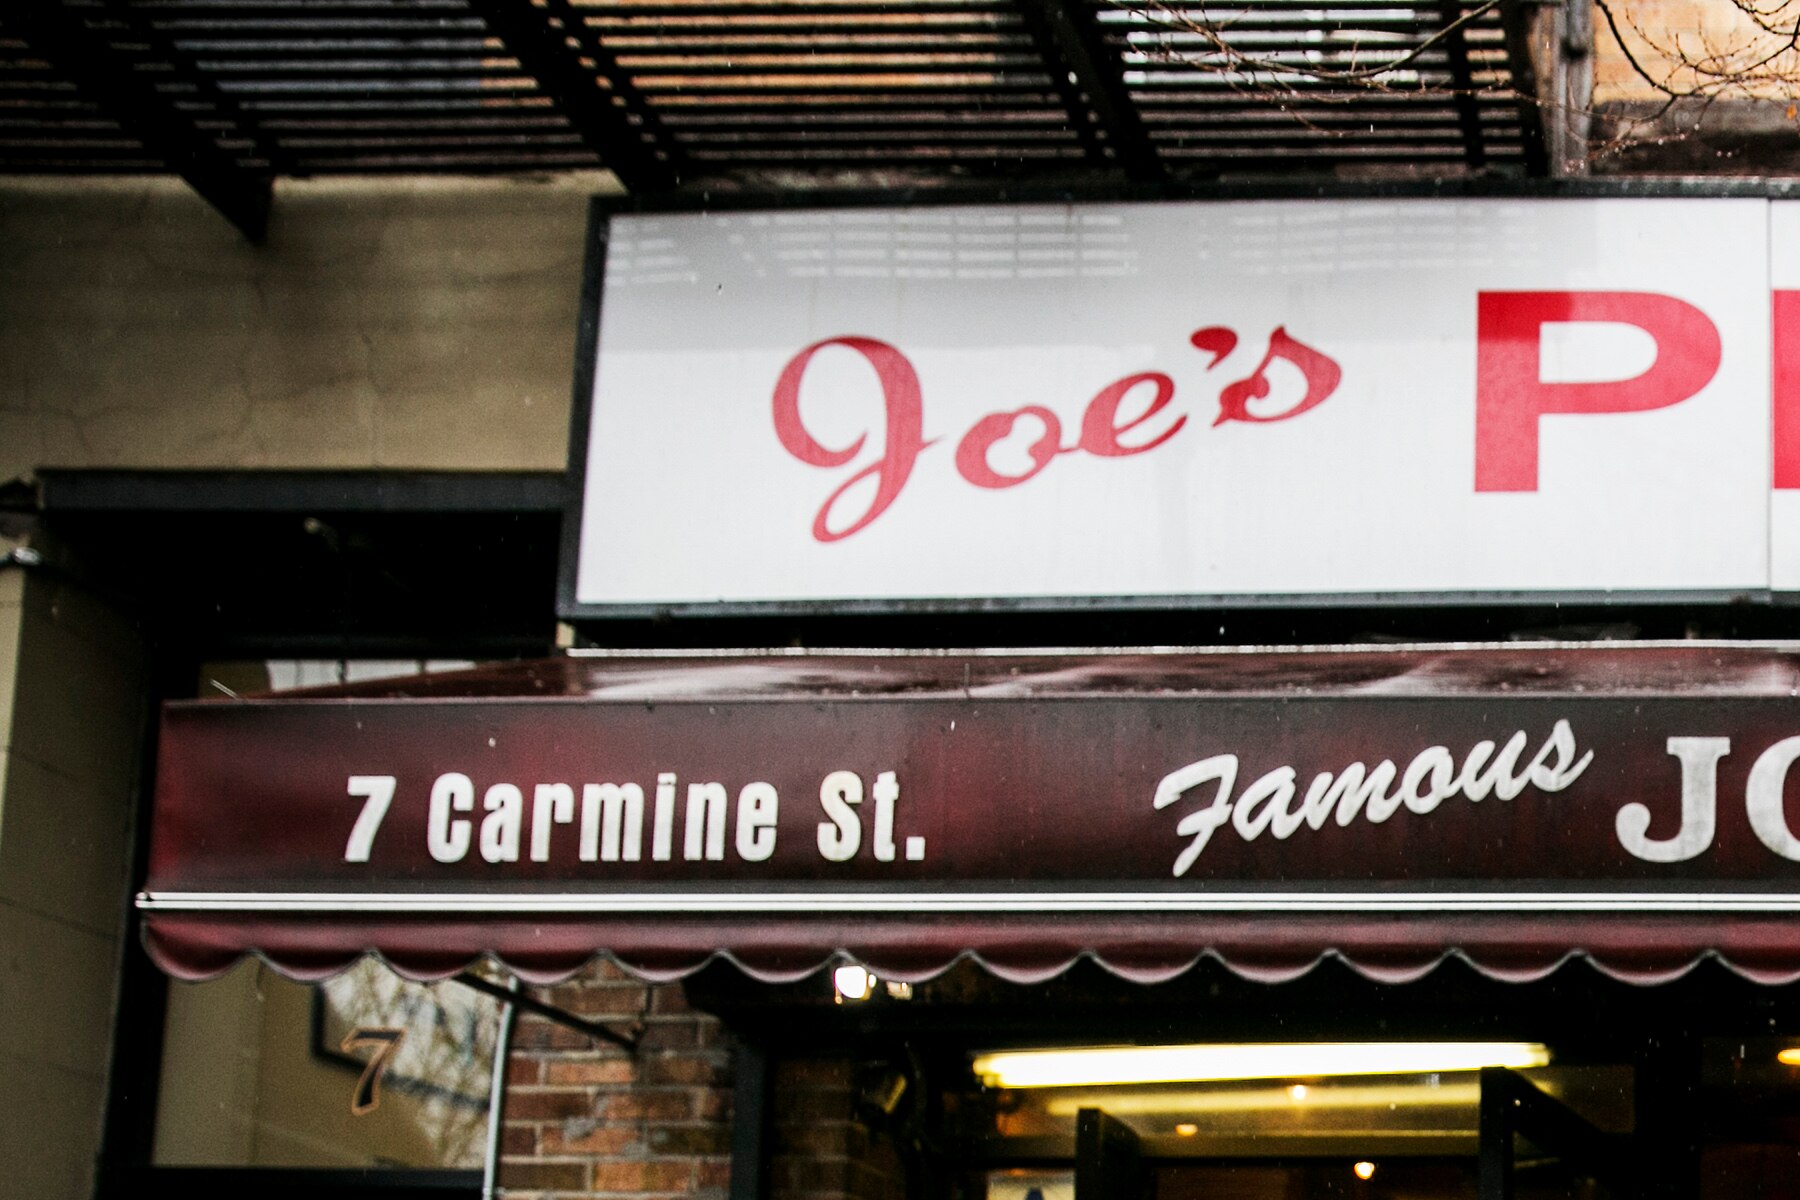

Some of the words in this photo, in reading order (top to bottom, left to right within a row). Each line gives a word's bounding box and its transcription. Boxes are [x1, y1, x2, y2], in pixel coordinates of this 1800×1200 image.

[772, 326, 1342, 544] Joe's
[346, 775, 397, 862] 7
[428, 773, 777, 863] Carmine
[817, 770, 926, 863] St.
[1154, 719, 1594, 877] Famous
[341, 1027, 408, 1115] 7
